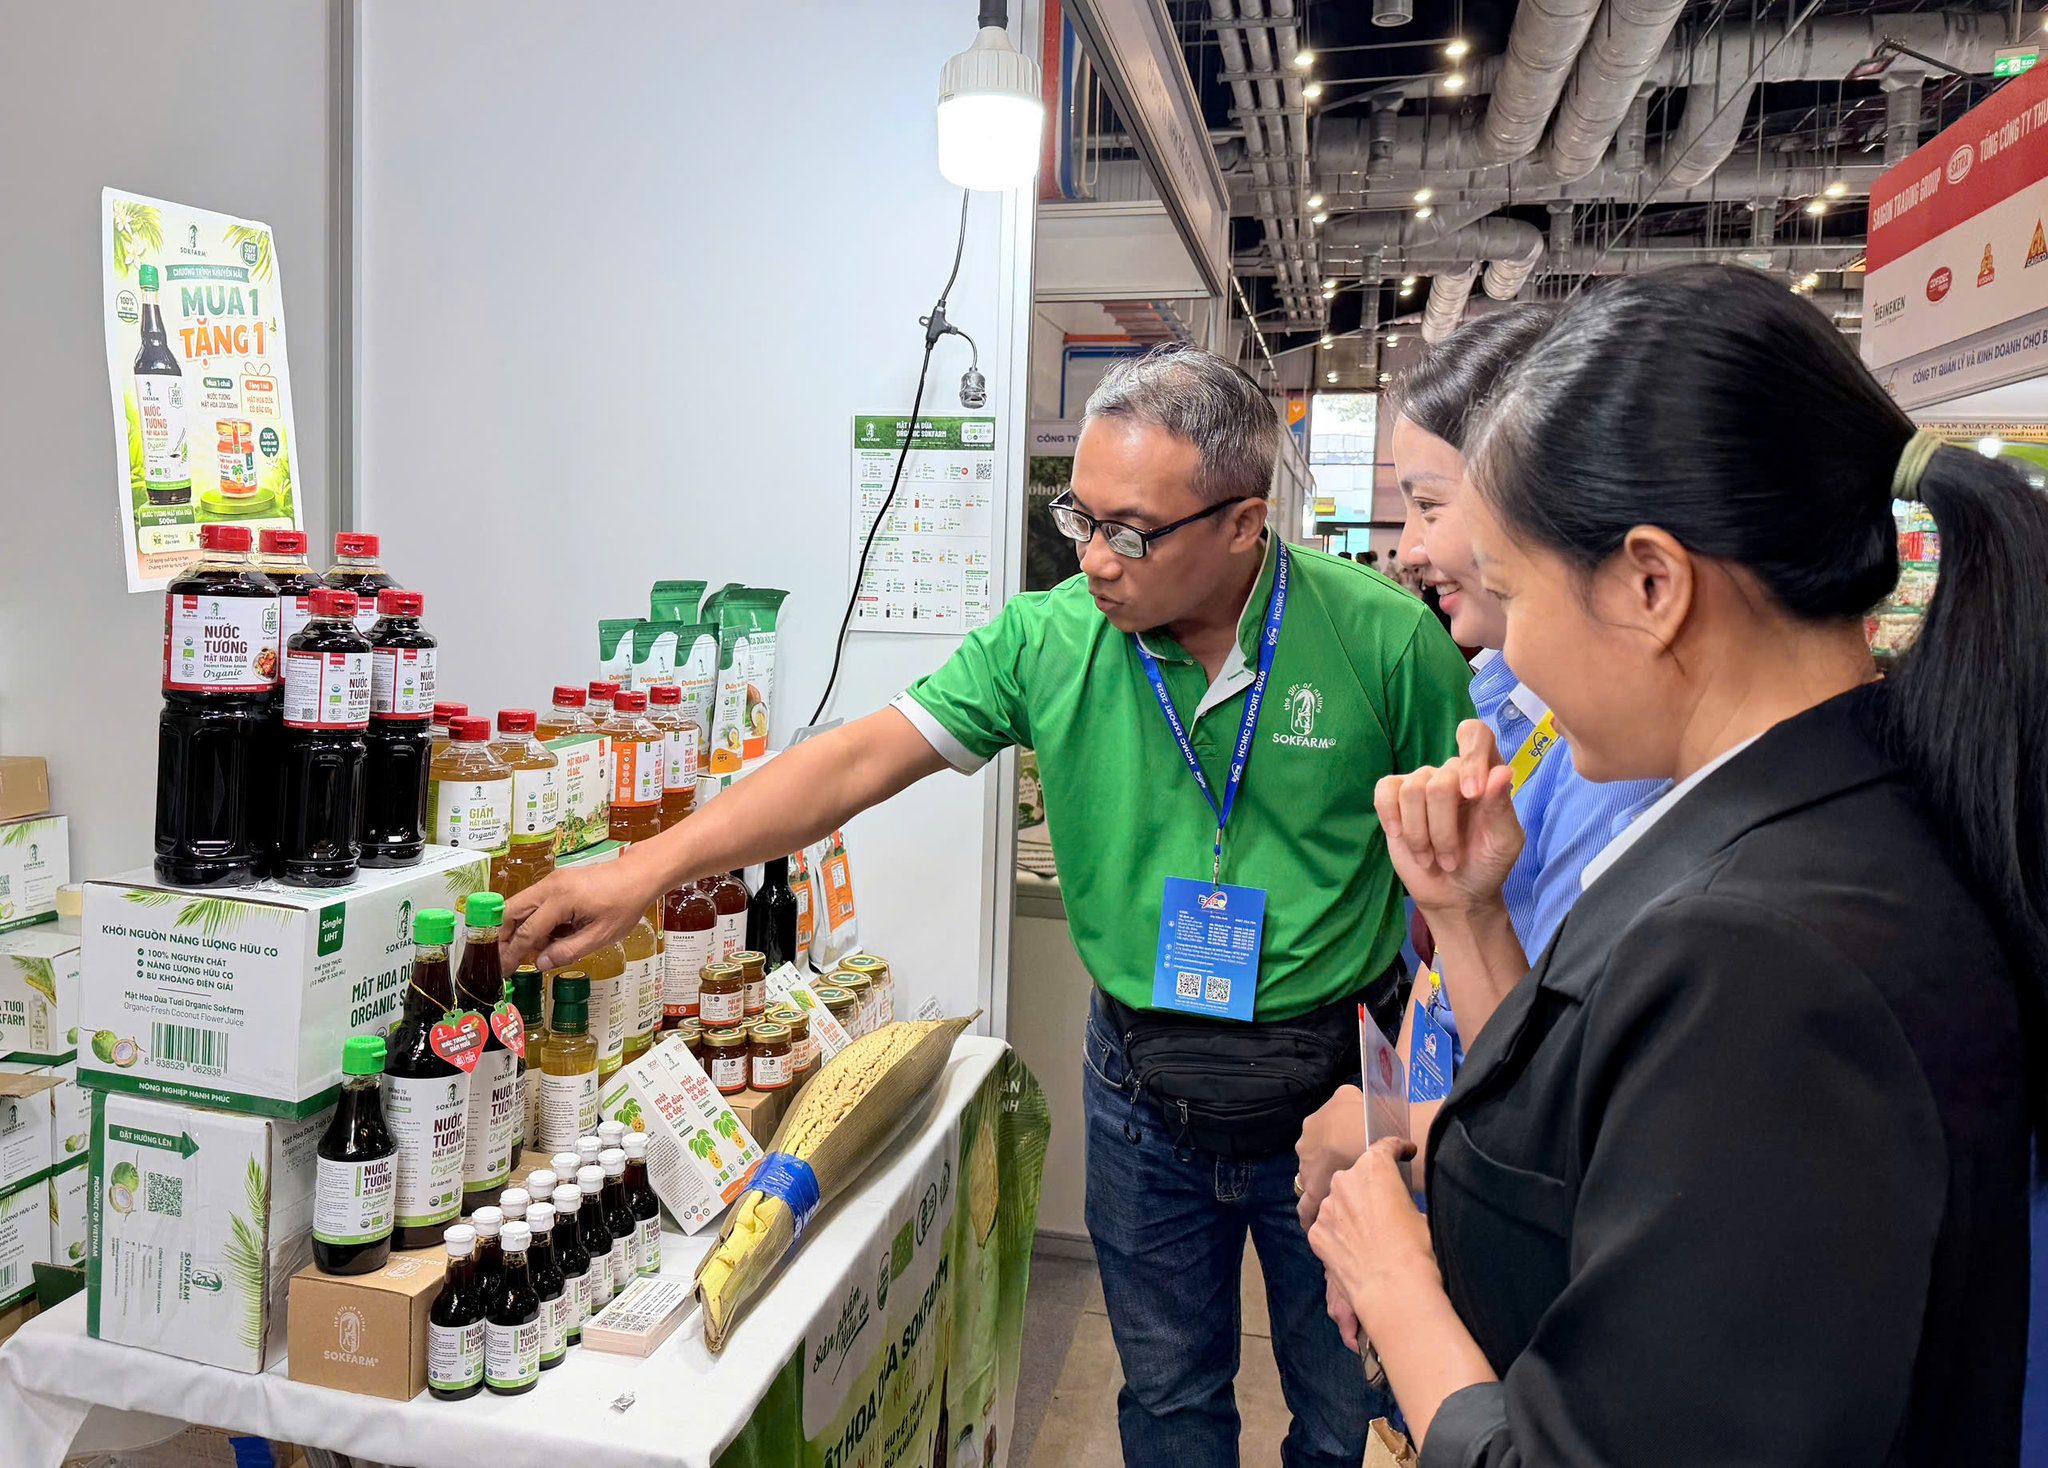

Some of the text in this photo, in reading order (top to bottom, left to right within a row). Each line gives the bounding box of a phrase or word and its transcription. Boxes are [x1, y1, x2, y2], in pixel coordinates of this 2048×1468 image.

[1979, 130, 1999, 163] TỔNG
[1999, 116, 2020, 150] CÔNG
[2021, 108, 2032, 138] TY
[1949, 152, 1969, 176] SATRA
[1872, 166, 1941, 231] SAIGON TRADING GROUP
[244, 243, 257, 254] SOY
[244, 252, 257, 262] FREE
[120, 296, 135, 306] 100%
[181, 286, 259, 317] MUA 1
[1875, 296, 1906, 322] HEINEKEN
[180, 318, 264, 366] TẶNG 1
[1912, 367, 1930, 385] CÔNG
[1930, 364, 1938, 379] TY
[1938, 357, 1957, 376] QUẢN
[1957, 353, 1966, 370] LÝ
[1966, 349, 1976, 367] VÀ
[1976, 345, 1994, 364] KINH
[1994, 336, 2021, 359] DOANH
[2022, 327, 2042, 351] CHỢ
[207, 392, 218, 400] NƯỚC
[143, 405, 162, 418] NƯỚC
[145, 416, 170, 431] TƯƠNG
[896, 421, 907, 430] MẬT
[921, 420, 933, 430] DỪA
[921, 430, 947, 438] SOKFARM
[1037, 433, 1065, 443] CÔNG
[1277, 556, 1288, 590] EXPORT
[1272, 590, 1285, 621] HCMC
[267, 611, 278, 621] SOY
[204, 622, 240, 639] NƯỚC
[265, 621, 278, 631] FREE
[204, 639, 248, 654] TƯƠNG
[204, 653, 248, 664] MẬT HOA DỪA
[203, 669, 243, 680] Organic
[349, 675, 368, 689] NƯỚC
[1282, 682, 1324, 714] the gift of nature
[1236, 670, 1267, 759] HCMC EXPORT 2026
[1155, 682, 1196, 766] HCMC EXPORT 2026
[470, 803, 494, 819] GIẤM
[468, 830, 497, 842] Organic
[321, 916, 343, 930] Single
[102, 924, 279, 963] KHỞI NGUỒN NĂNG LƯỢNG HỮU CƠ
[324, 930, 339, 943] UHT
[147, 949, 227, 972] 100% NGUYÊN CHẤT
[147, 959, 234, 985] NĂNG LƯỢNG HỮU CƠ
[146, 970, 234, 997] BÙ KHOÁNG ĐIỆN GIẢI
[4, 999, 24, 1013] TƯƠI
[124, 990, 245, 1016] Mật Hoa Dừa Tươi Organic Sokfarm
[350, 992, 397, 1028] ORGANIC
[123, 1000, 244, 1027] Organic Fresh Coconut Flower Juice
[143, 1056, 222, 1077] 8 938529 062938
[680, 1074, 694, 1088] mật
[685, 1076, 709, 1095] hoa dừa
[138, 1081, 230, 1103] NÔNG NGHIỆP HẠNH PHÚC
[654, 1091, 669, 1107] mật
[690, 1086, 710, 1102] cô đặc
[435, 1099, 464, 1111] SOKFARM
[659, 1093, 684, 1114] hoa dừa
[665, 1105, 686, 1121] cô đặc
[433, 1112, 463, 1133] NƯỚC
[119, 1129, 172, 1147] ĐẶT HƯỚNG LÊN
[432, 1126, 466, 1148] TƯƠNG
[363, 1160, 389, 1177] NƯỚC
[363, 1171, 393, 1188] TƯƠNG
[93, 1213, 100, 1222] OF
[91, 1223, 100, 1257] VIETNAM
[183, 1251, 191, 1300] SOKFARM
[465, 1322, 483, 1339] NƯỚC
[519, 1323, 538, 1340] NƯỚC
[323, 1349, 378, 1367] SOKFARM
[812, 1332, 835, 1374] Sản
[843, 1390, 877, 1460] HOA
